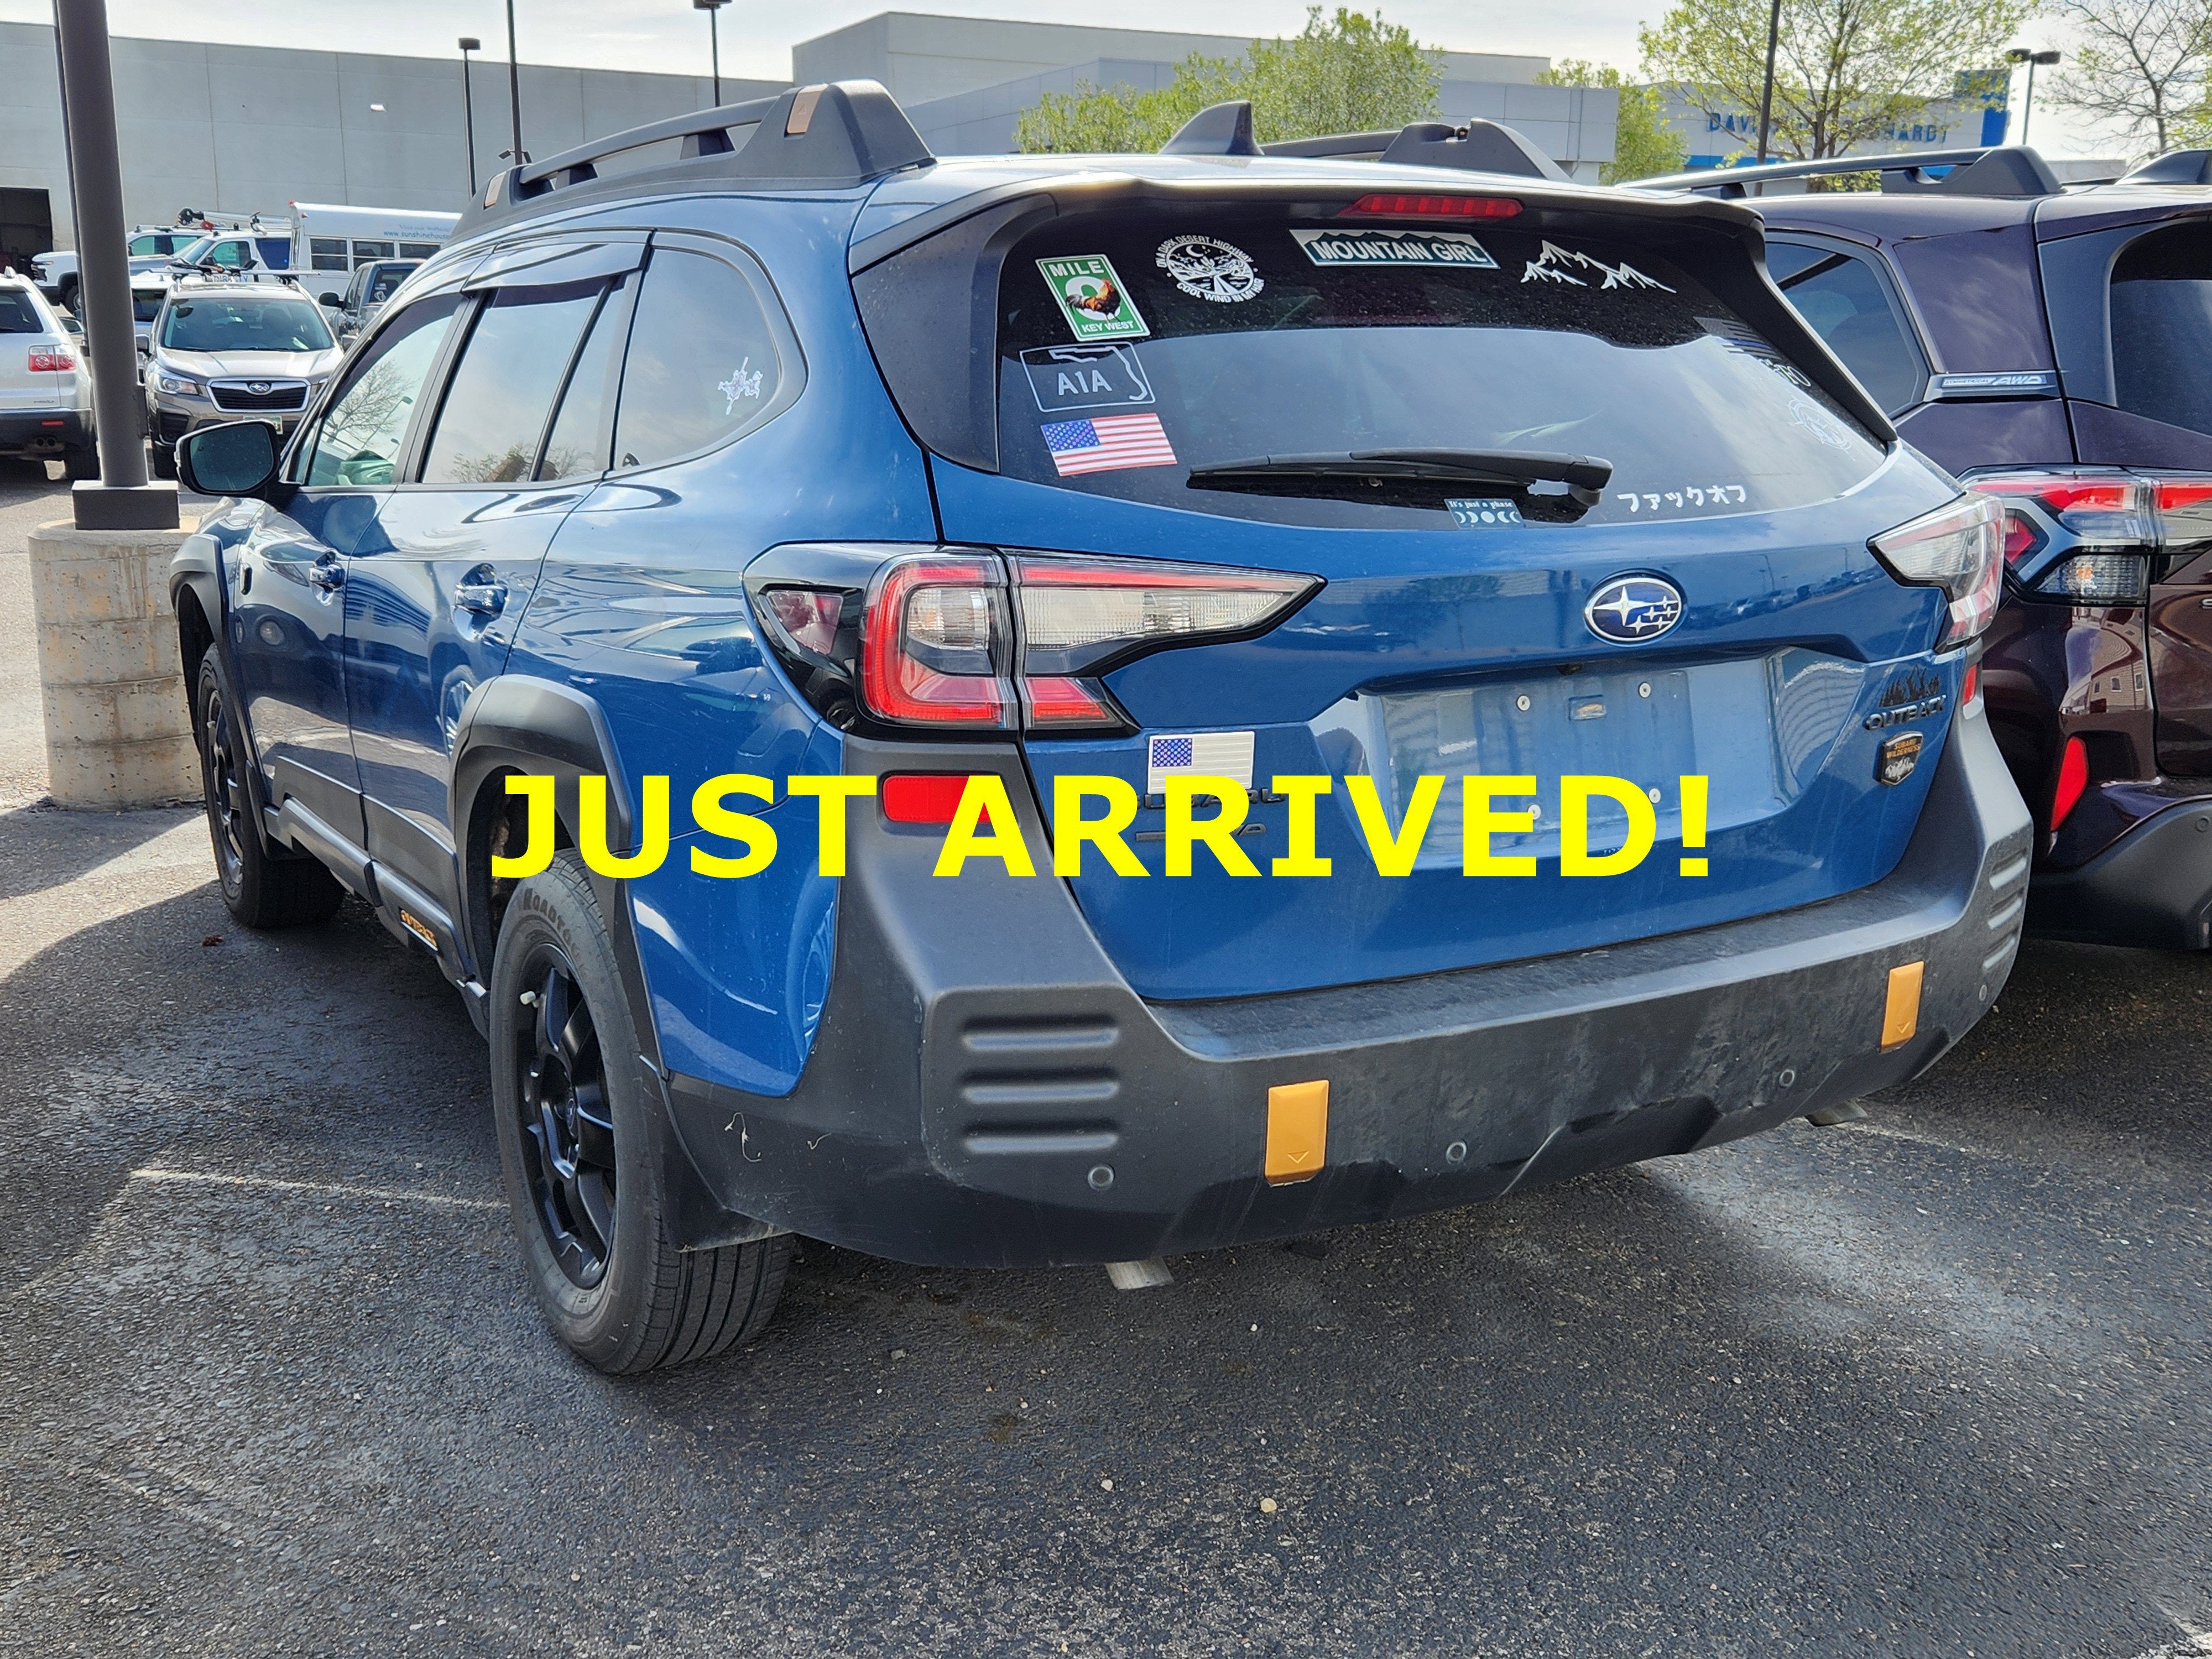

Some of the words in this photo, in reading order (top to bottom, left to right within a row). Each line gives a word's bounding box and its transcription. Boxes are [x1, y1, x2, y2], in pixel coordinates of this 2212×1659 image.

[1157, 238, 1178, 253] DARK
[1175, 234, 1211, 243] DESERT
[1213, 238, 1254, 262] HIGHWAY
[1311, 241, 1433, 260] MOUNTAIN
[1431, 243, 1488, 263] GIRL
[1048, 260, 1104, 277] MILE
[1176, 282, 1202, 299] COOL
[1204, 292, 1232, 303] WIND
[1230, 294, 1244, 303] IN
[1240, 289, 1257, 300] MY
[1081, 323, 1104, 333] KEY
[1105, 320, 1134, 331] WEST
[1057, 369, 1113, 396] A1A
[1991, 374, 2043, 385] AWD
[1464, 500, 1480, 509] just
[1489, 500, 1514, 510] phase
[1865, 695, 1947, 731] OUTBACK
